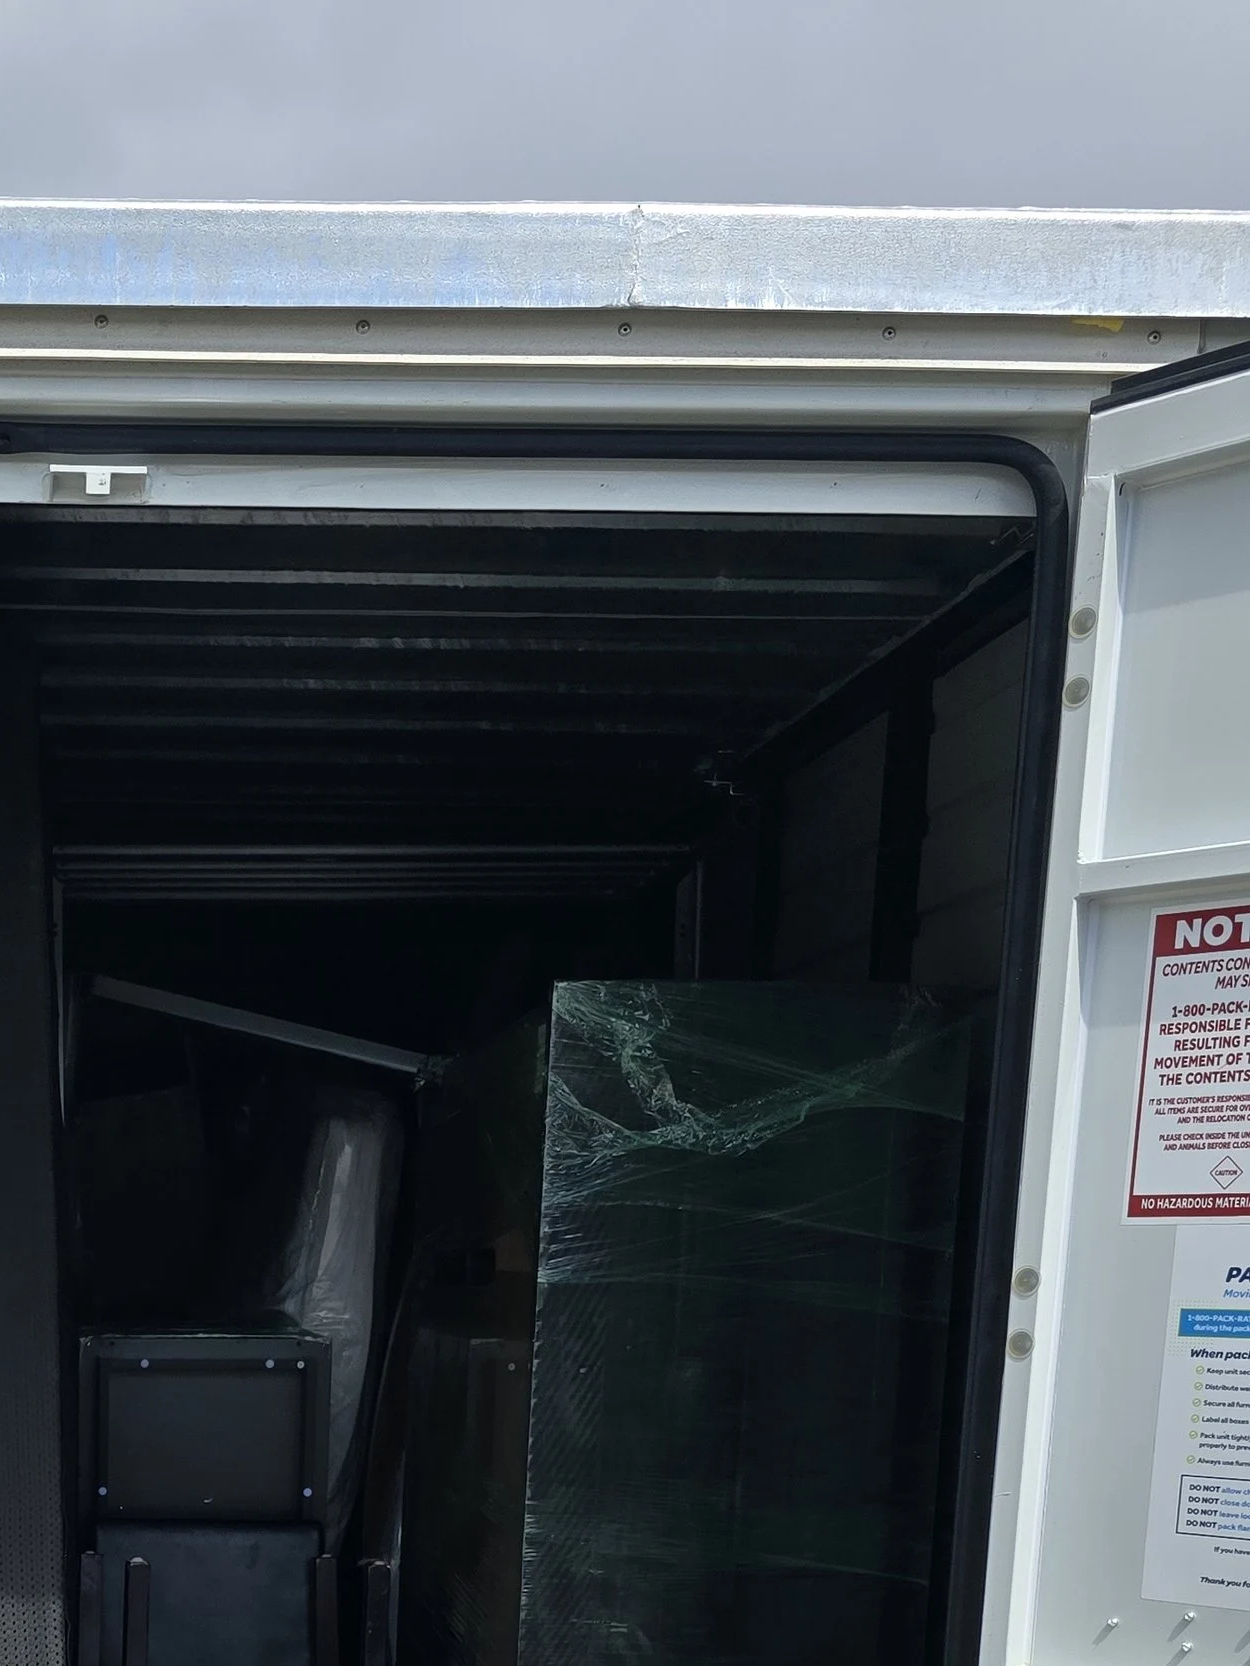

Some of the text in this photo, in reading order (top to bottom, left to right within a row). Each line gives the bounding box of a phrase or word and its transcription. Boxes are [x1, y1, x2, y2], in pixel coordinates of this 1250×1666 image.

[1162, 959, 1224, 977] CONTENTS
[1214, 974, 1242, 990] MAY
[1171, 1000, 1250, 1018] 1-800-PACK-
[1159, 1018, 1242, 1036] RESPONSIBLE
[1173, 1036, 1241, 1052] RESULTING
[1153, 1054, 1223, 1070] MOVEMENT
[1226, 1052, 1243, 1066] OF
[1158, 1069, 1250, 1086] THE CONTENTS
[1148, 1098, 1156, 1106] IT
[1155, 1098, 1162, 1106] IS
[1163, 1097, 1176, 1105] THE
[1176, 1095, 1216, 1105] CUSTOMER'S
[1154, 1108, 1166, 1116] ALL
[1167, 1107, 1186, 1115] ITEMS
[1186, 1106, 1199, 1114] ARE
[1200, 1105, 1224, 1114] SECURE
[1225, 1104, 1238, 1113] FOR
[1177, 1116, 1191, 1124] AND
[1192, 1116, 1205, 1124] THE
[1206, 1114, 1246, 1123] RELOCATION
[1158, 1133, 1182, 1142] PLEASE
[1183, 1133, 1204, 1141] CHECK
[1205, 1132, 1226, 1140] INSIDE
[1227, 1131, 1240, 1139] THE
[1163, 1143, 1178, 1151] AND
[1178, 1142, 1206, 1151] ANIMALS
[1207, 1142, 1231, 1150] BEFORE
[1214, 1169, 1238, 1177] CAUTION
[1141, 1196, 1250, 1210] NO HAZARDOUS MATERI
[1193, 1324, 1218, 1333] during
[1190, 1348, 1223, 1359] When
[1206, 1367, 1224, 1376] Keep
[1205, 1383, 1239, 1392] Distribute
[1198, 1442, 1227, 1451] properly
[1197, 1457, 1221, 1466] Always
[1202, 1485, 1221, 1493] NOT
[1221, 1487, 1242, 1495] allow
[1188, 1495, 1201, 1503] DO
[1201, 1496, 1220, 1505] NOT
[1220, 1499, 1240, 1507] close
[1187, 1507, 1200, 1515] DO
[1200, 1508, 1219, 1517] NOT
[1219, 1511, 1239, 1519] leave
[1186, 1519, 1198, 1527] DO
[1199, 1520, 1217, 1529] NOT
[1217, 1523, 1236, 1531] pack
[1220, 1547, 1233, 1555] you
[1200, 1576, 1226, 1586] Thank
[1225, 1579, 1241, 1588] you
